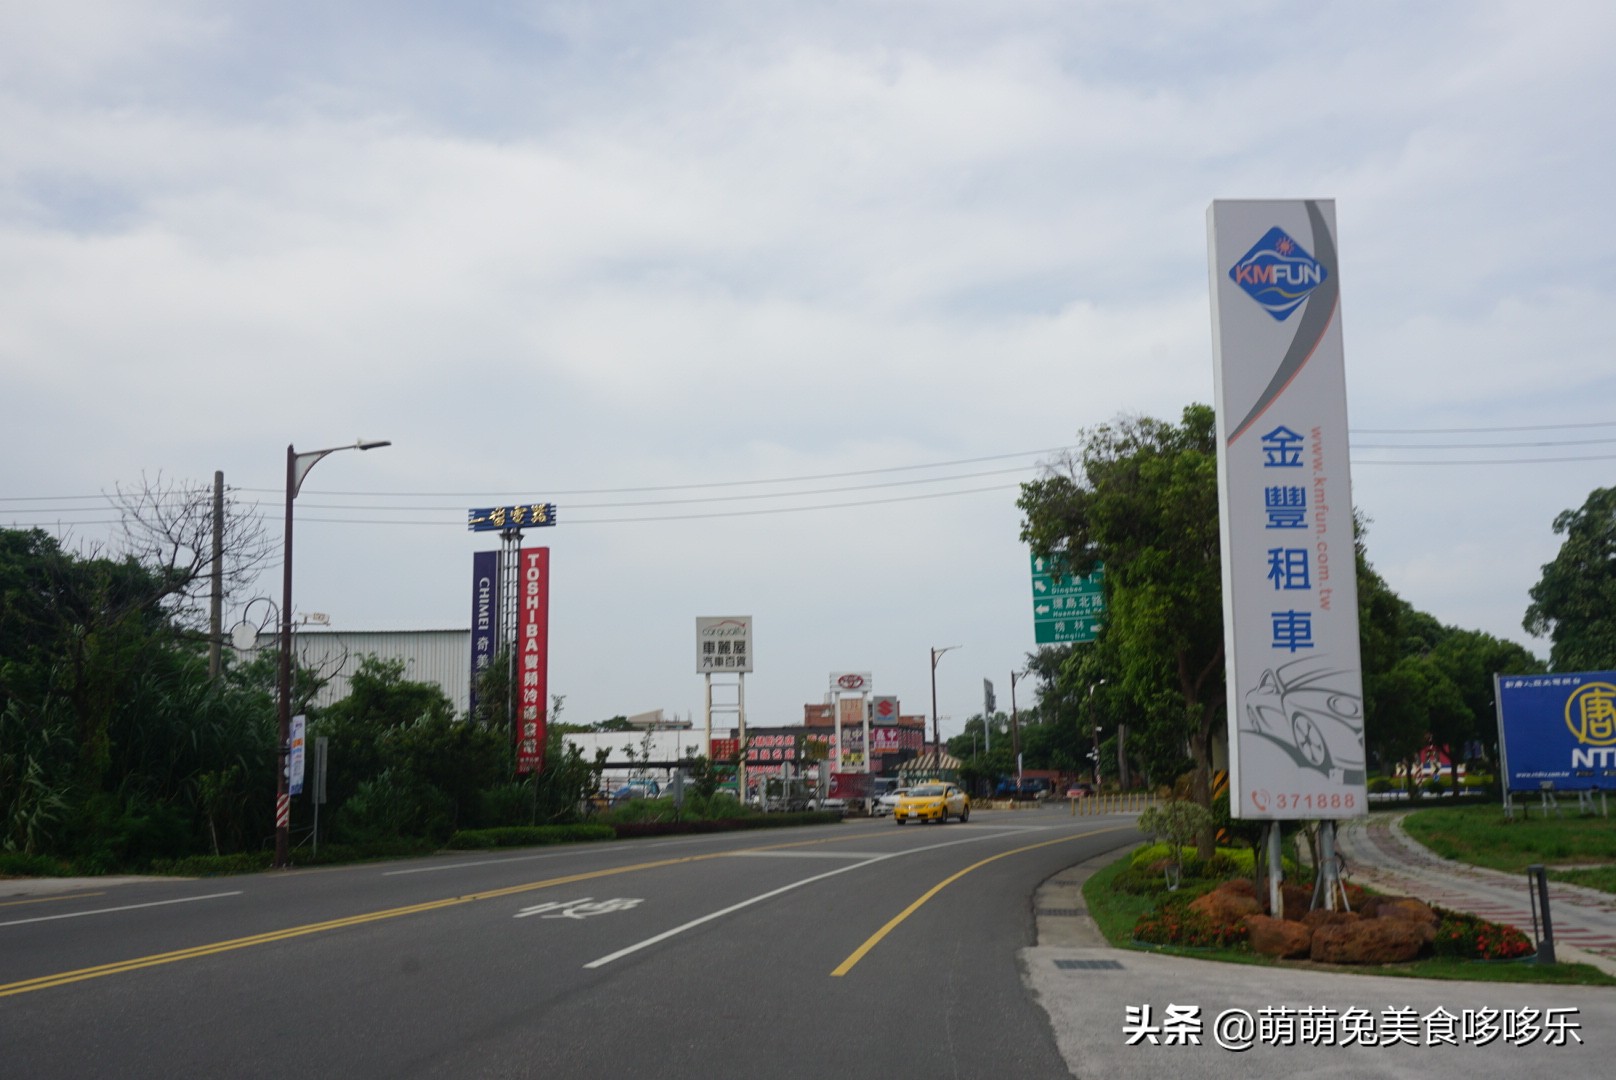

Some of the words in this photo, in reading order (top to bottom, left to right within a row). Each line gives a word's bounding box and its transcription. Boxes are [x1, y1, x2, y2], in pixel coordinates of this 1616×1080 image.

[1236, 264, 1321, 285] KMFUN
[1261, 425, 1314, 653] 金豐租車
[1311, 426, 1333, 611] www.kmfun.com.tw
[478, 577, 490, 630] CHIMEI
[525, 553, 540, 652] TOSHIBA
[1572, 748, 1616, 768] NT
[1276, 793, 1355, 809] 371888
